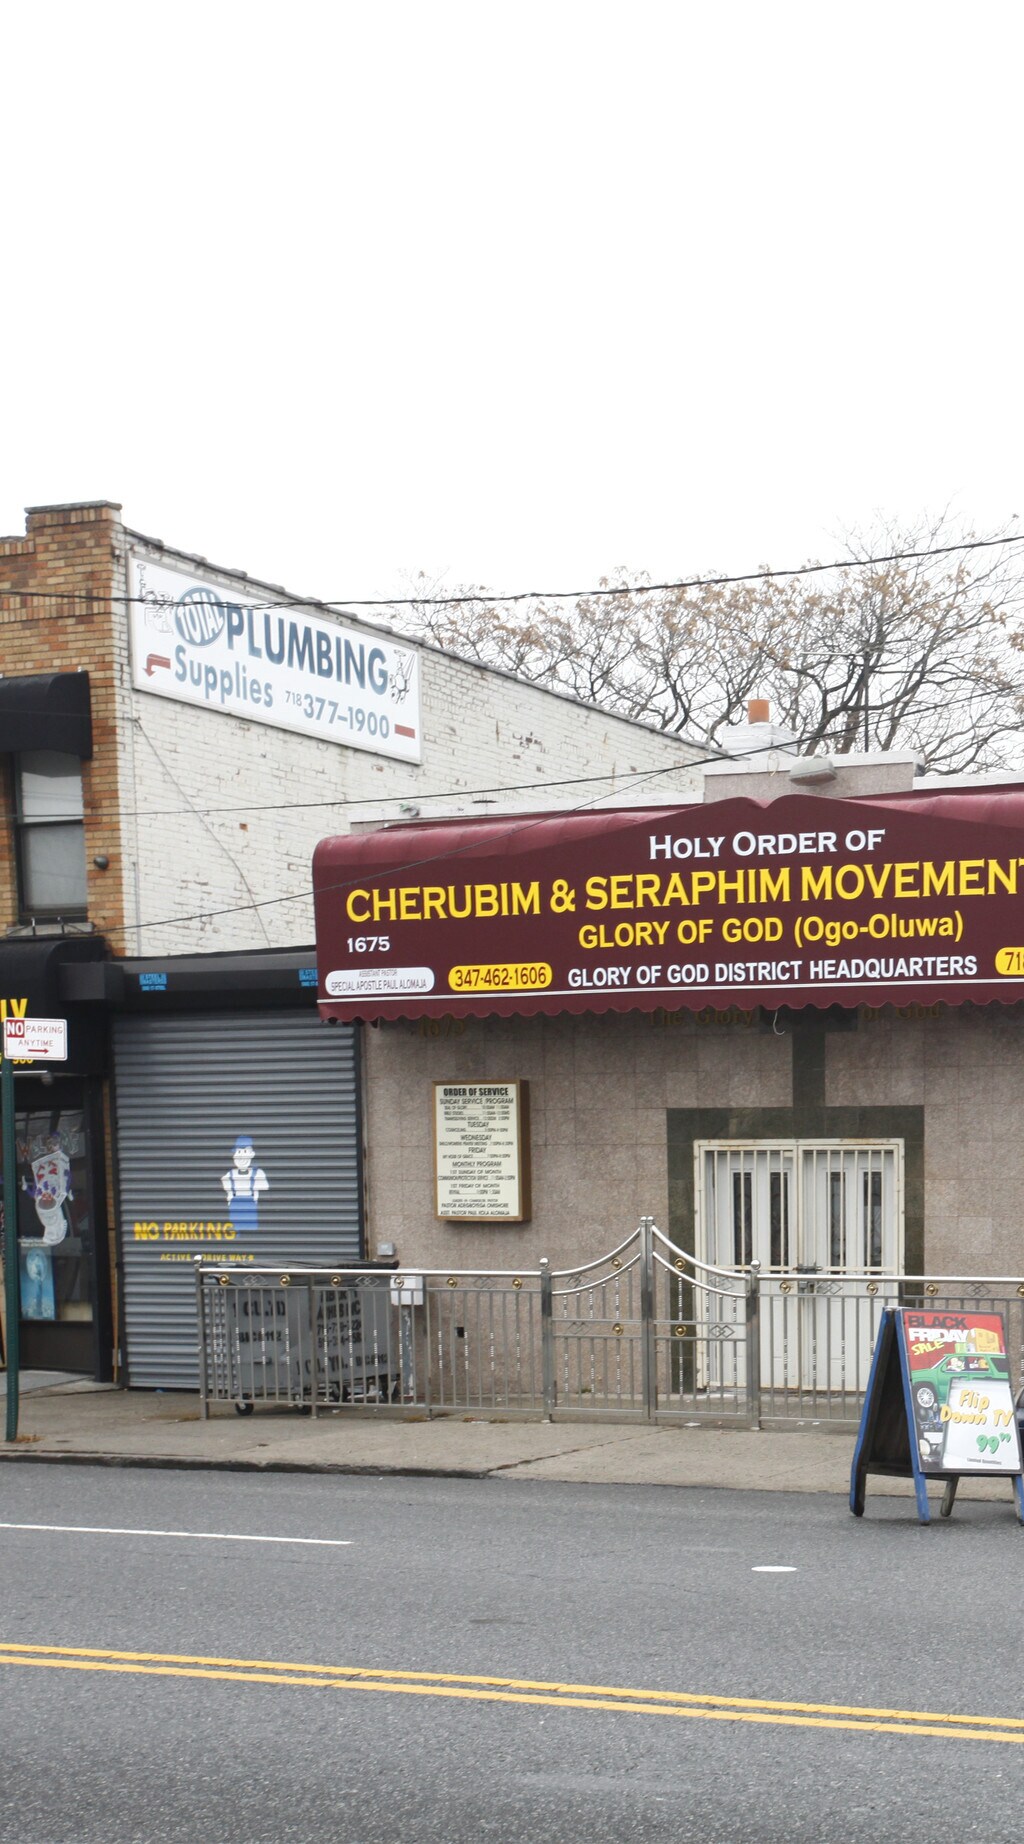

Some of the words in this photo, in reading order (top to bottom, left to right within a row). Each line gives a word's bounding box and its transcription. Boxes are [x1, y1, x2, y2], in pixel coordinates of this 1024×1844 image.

[177, 591, 225, 643] TOTAL
[226, 602, 389, 696] PLUMBING
[174, 645, 274, 708] Supplies
[285, 690, 303, 707] 718
[650, 834, 725, 860] HOLY
[732, 830, 837, 857] ORDER
[846, 829, 885, 852] OF
[346, 882, 541, 922] CHERUBIM
[550, 879, 576, 913] &
[585, 866, 791, 911] SERAPHIM
[578, 921, 671, 949] GLORY
[677, 920, 714, 945] OF
[721, 917, 784, 943] GOD
[793, 910, 964, 949] (Ogo-Oluwa)
[347, 936, 391, 953] 1675
[454, 966, 548, 988] 347-462-1606
[568, 966, 632, 988] GLORY
[636, 964, 663, 986] OF
[666, 963, 709, 985] GOD
[715, 960, 802, 983] DISTRICT
[809, 955, 978, 981] HEADQUARTERS
[331, 981, 355, 991] SPECIAL
[356, 980, 382, 991] APOSTLE
[383, 979, 399, 990] PAUL
[7, 1021, 24, 1036] NO
[26, 1025, 64, 1034] PARKING
[18, 1039, 54, 1047] ANYTIME
[443, 1087, 467, 1096] ORDER
[468, 1087, 477, 1096] OF
[479, 1087, 509, 1096] SERVICE
[133, 1221, 159, 1240] NO
[163, 1222, 236, 1241] PARKING
[160, 1253, 191, 1262] ACTIVE
[908, 1315, 967, 1329] BLACK
[908, 1328, 969, 1343] FRIDAY
[911, 1339, 945, 1355] SALE
[958, 1389, 990, 1411] Flip
[940, 1404, 987, 1425] Down
[993, 1409, 1015, 1427] TV
